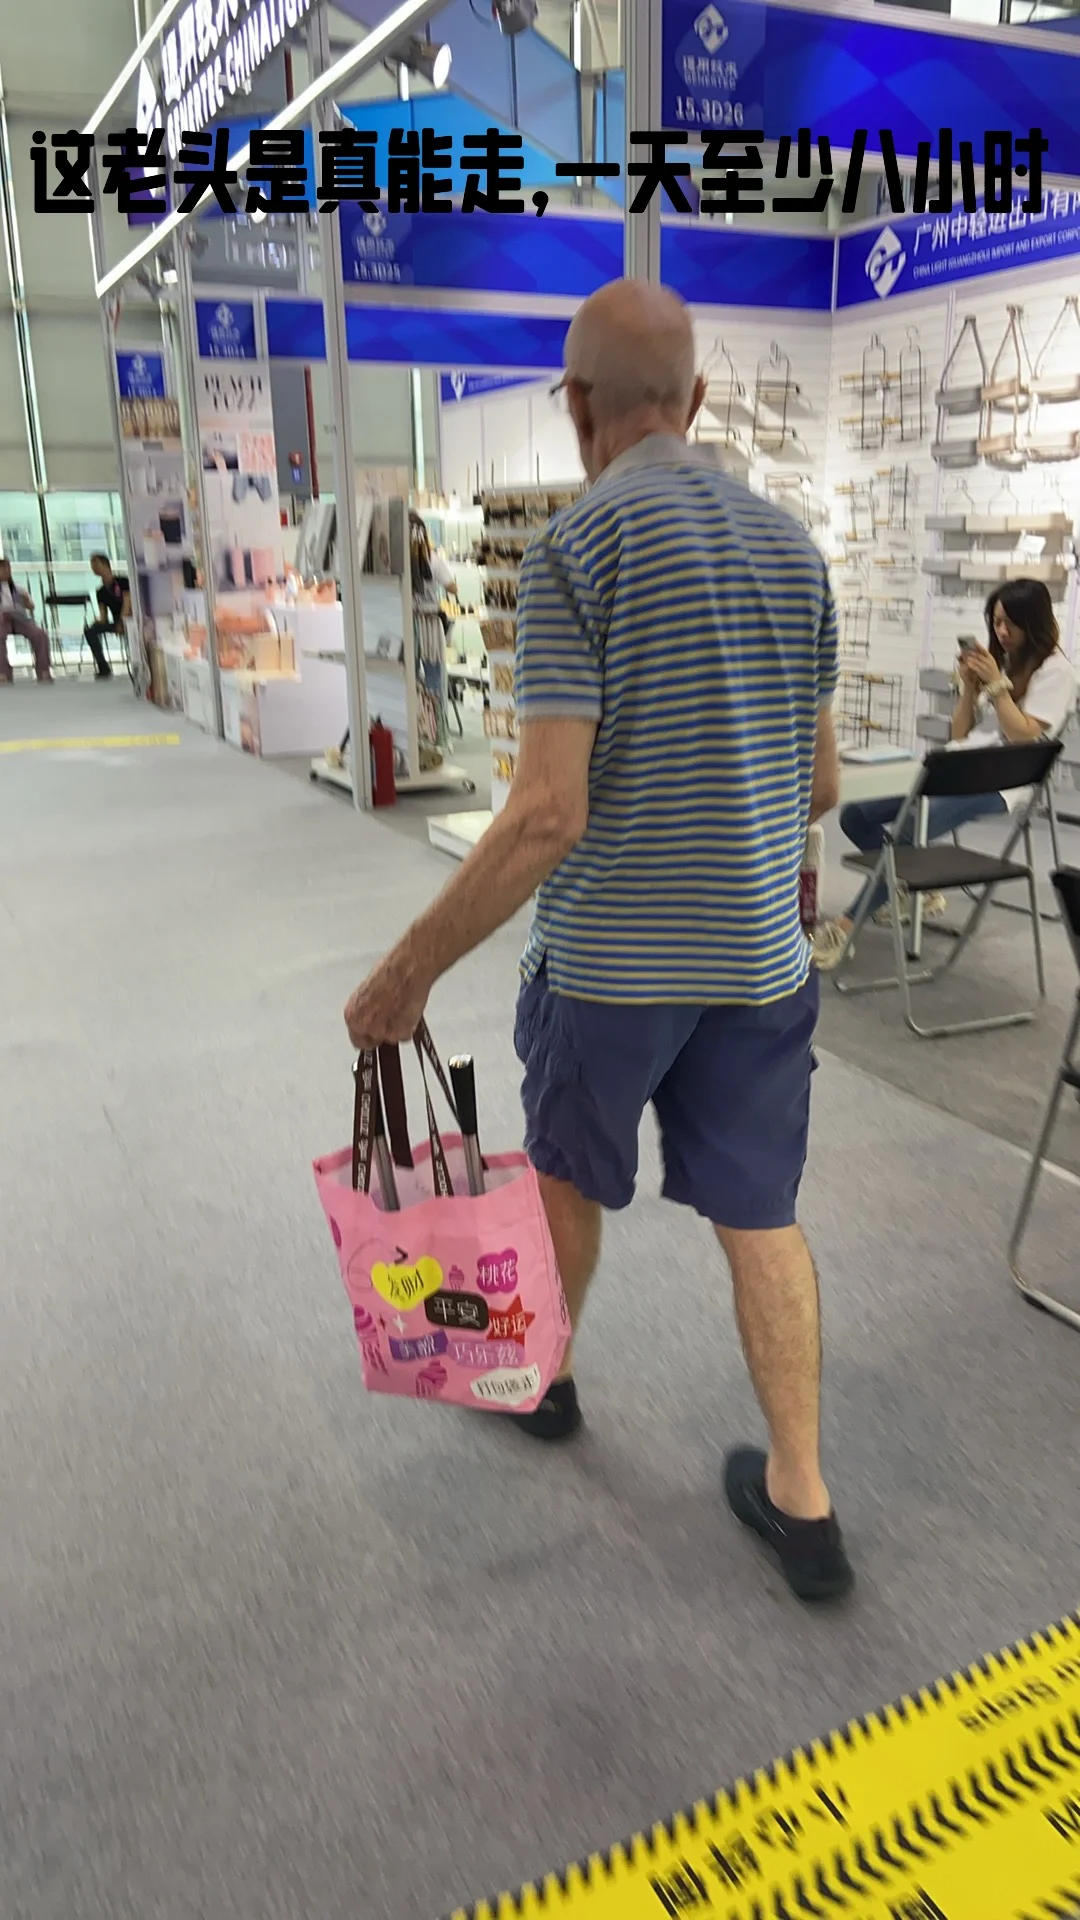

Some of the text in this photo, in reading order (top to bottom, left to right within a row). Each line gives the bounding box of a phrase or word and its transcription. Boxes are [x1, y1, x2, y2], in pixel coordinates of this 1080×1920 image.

[675, 95, 744, 127] 15.3D26
[1016, 239, 1030, 255] AND
[1031, 231, 1056, 251] EXPORT
[203, 373, 263, 394] PEACH
[387, 1268, 425, 1302] 发财
[479, 1258, 516, 1287] 桃花
[433, 1296, 481, 1327] 平安
[491, 1312, 526, 1338] 好运
[454, 1343, 519, 1366] 巧乐兹
